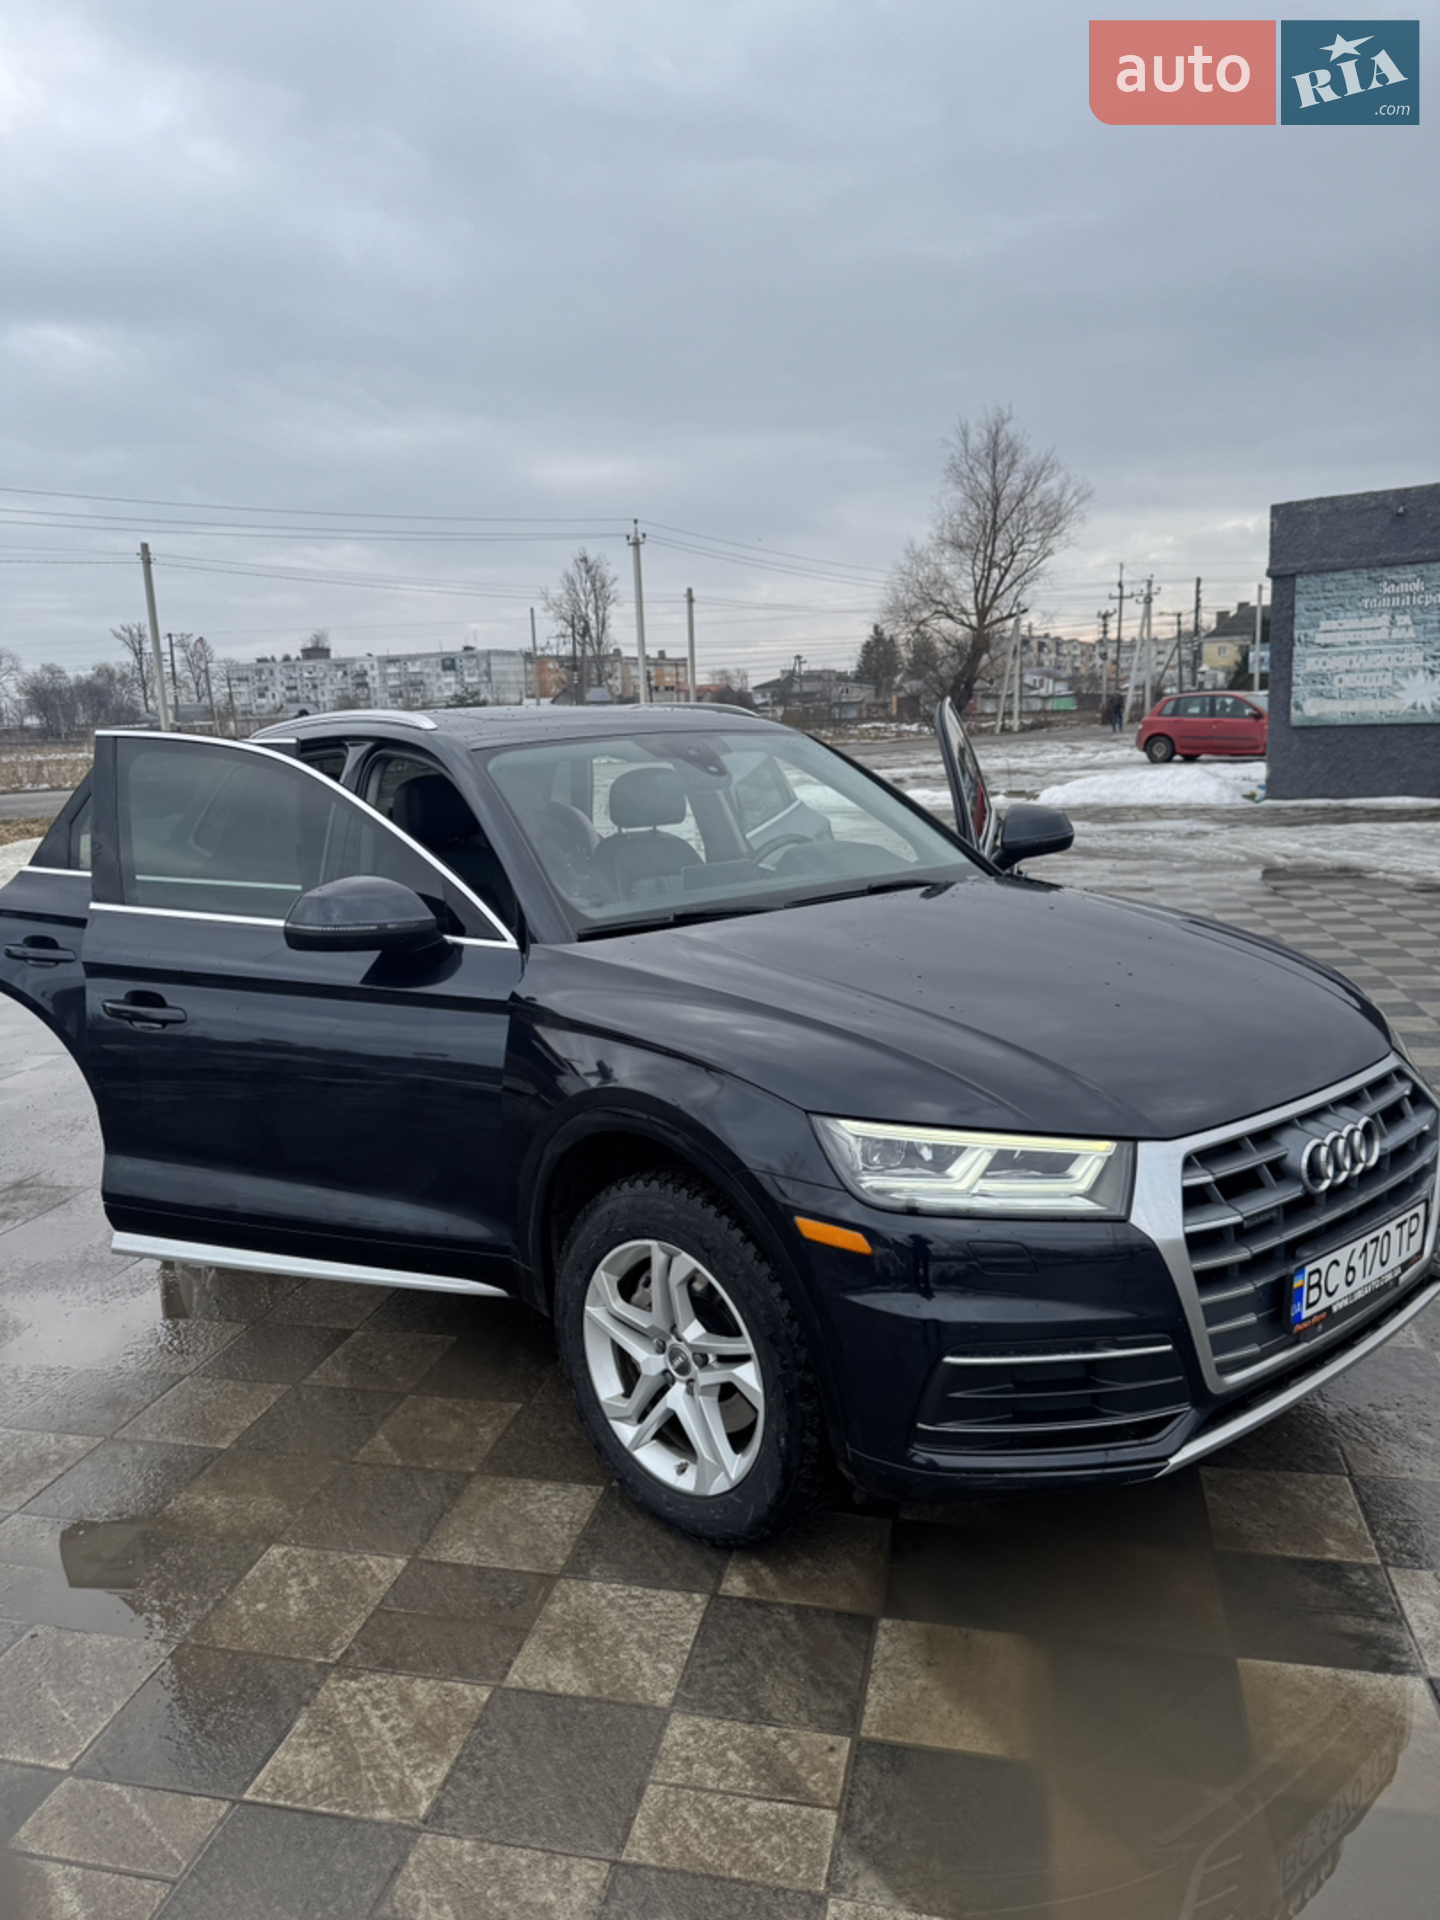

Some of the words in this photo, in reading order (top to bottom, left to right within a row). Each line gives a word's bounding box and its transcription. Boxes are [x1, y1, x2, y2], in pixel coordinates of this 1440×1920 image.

[1304, 1259, 1341, 1311] BC
[1344, 1229, 1392, 1288] 6170
[1396, 1211, 1421, 1257] TP
